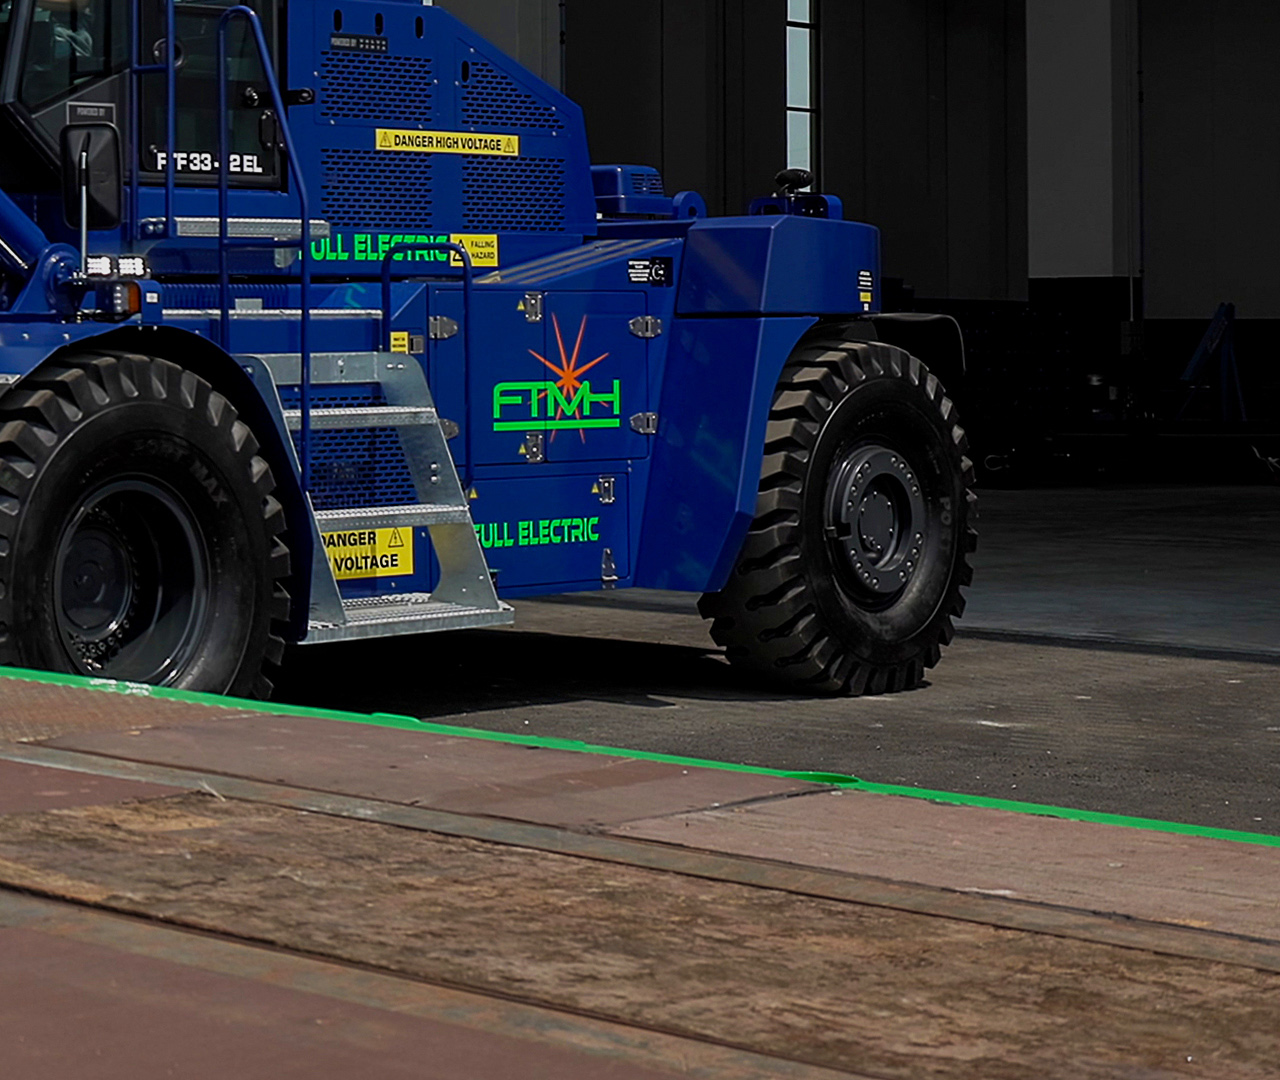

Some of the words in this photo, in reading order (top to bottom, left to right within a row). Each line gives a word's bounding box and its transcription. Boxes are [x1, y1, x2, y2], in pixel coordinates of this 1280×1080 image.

[393, 134, 436, 148] DANGER
[436, 136, 459, 149] HIGH
[460, 138, 502, 151] VOLTAGE
[299, 234, 349, 260] ULL
[354, 234, 448, 261] ELECTRIC
[471, 240, 495, 248] FALLING
[493, 379, 620, 418] FTMH
[518, 516, 600, 546] ELECTRIC
[334, 554, 399, 572] VOLTAGE
